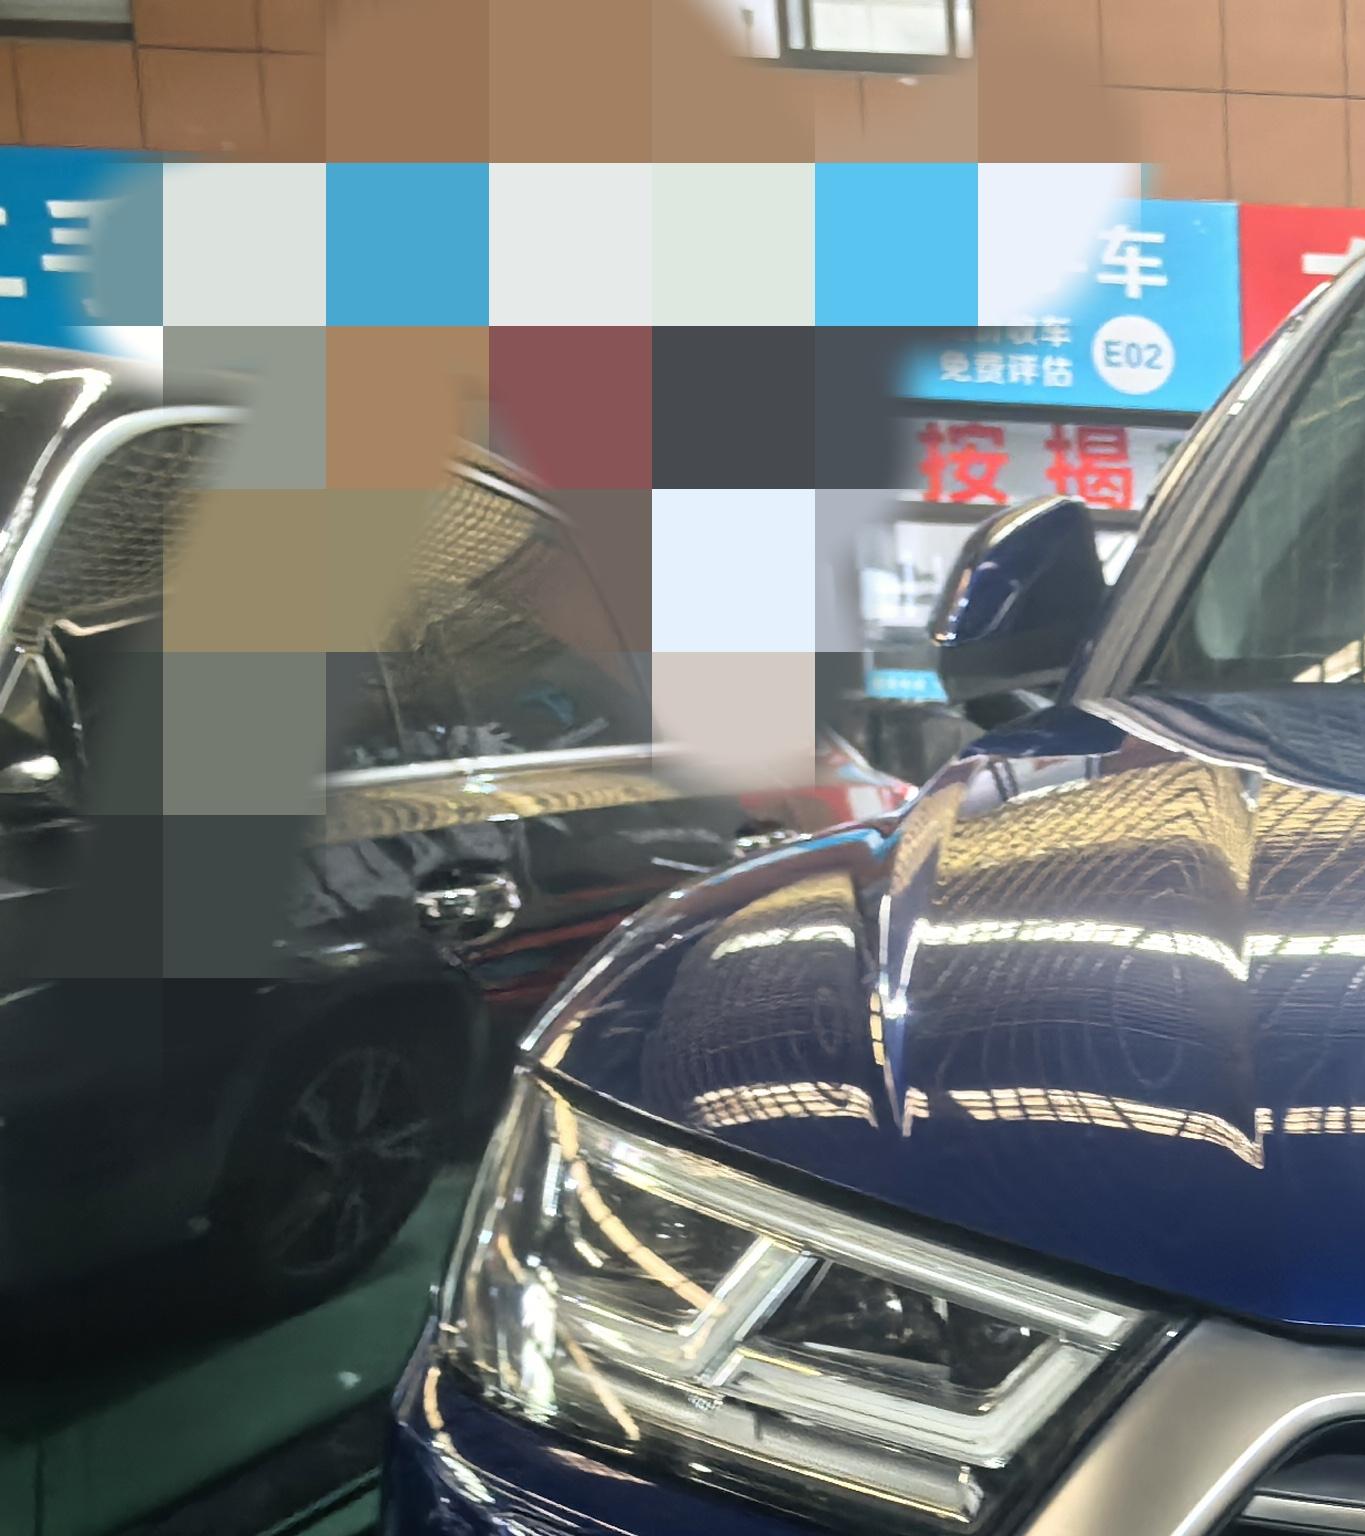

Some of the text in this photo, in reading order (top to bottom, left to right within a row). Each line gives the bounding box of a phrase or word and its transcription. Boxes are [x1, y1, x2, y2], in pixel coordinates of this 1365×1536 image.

[939, 349, 1074, 389] 免费评估
[1102, 339, 1164, 371] E02
[917, 421, 1135, 512] 按揭
